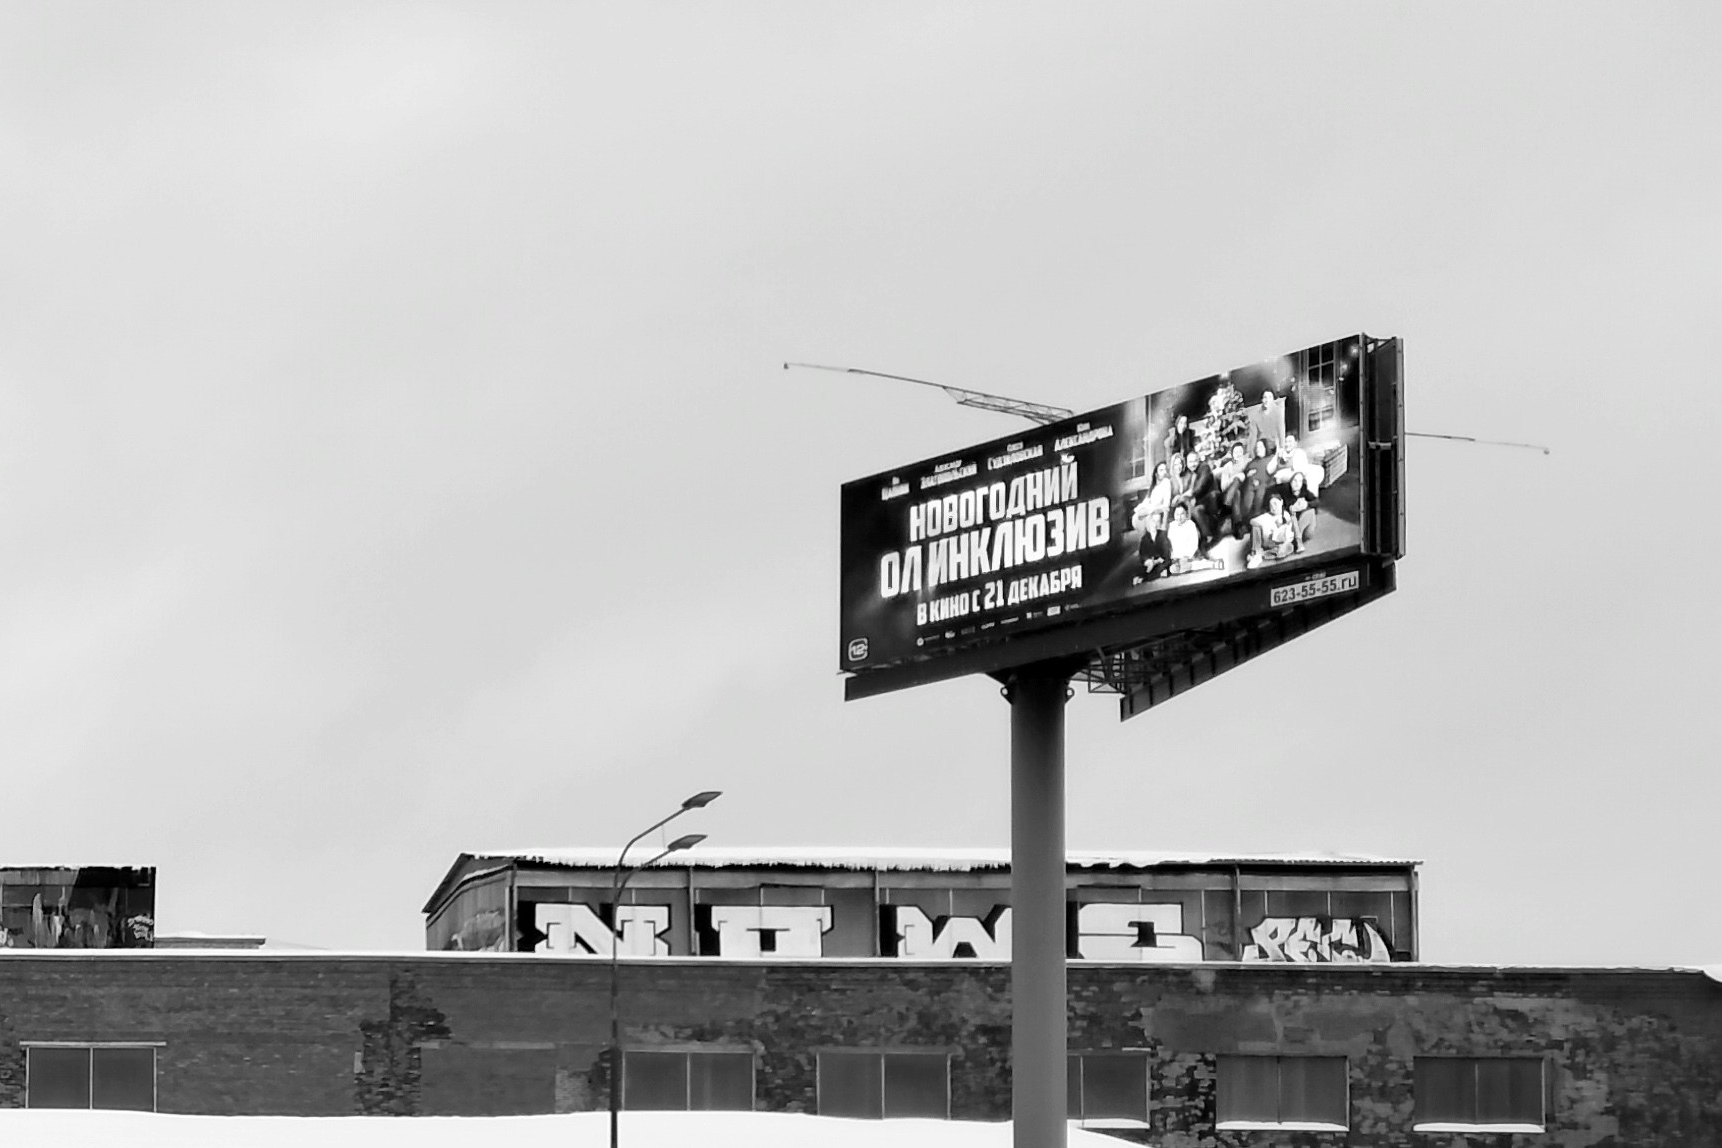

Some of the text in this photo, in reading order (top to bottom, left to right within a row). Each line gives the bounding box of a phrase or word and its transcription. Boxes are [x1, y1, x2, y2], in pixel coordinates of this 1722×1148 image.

[909, 454, 1078, 542] НОВОГОДНИЙ
[880, 497, 1110, 598] ОЛ ИНКЛЮЗИВ
[916, 564, 1083, 625] В КИНО С 21 ДЕКАБРЯ
[1273, 575, 1357, 604] 623-55-55.ru
